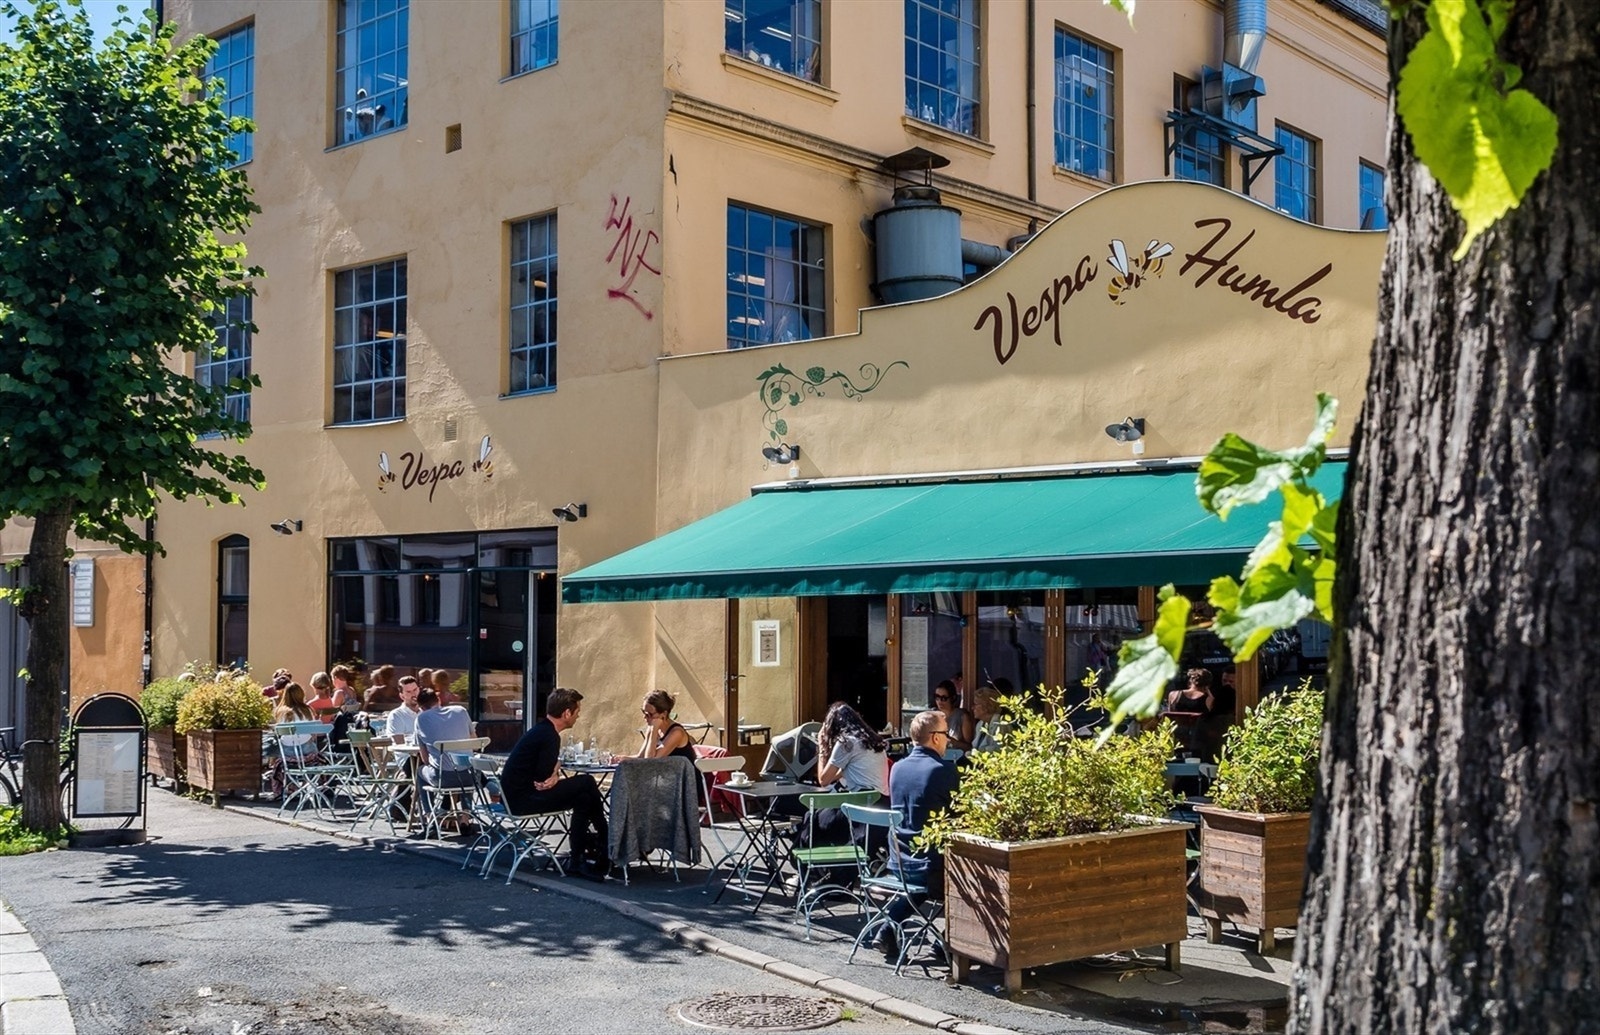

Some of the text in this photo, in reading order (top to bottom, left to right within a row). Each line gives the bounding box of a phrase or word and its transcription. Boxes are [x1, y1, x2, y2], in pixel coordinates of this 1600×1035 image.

[973, 218, 1333, 365] Vespa Humla
[400, 452, 465, 503] Vespa
